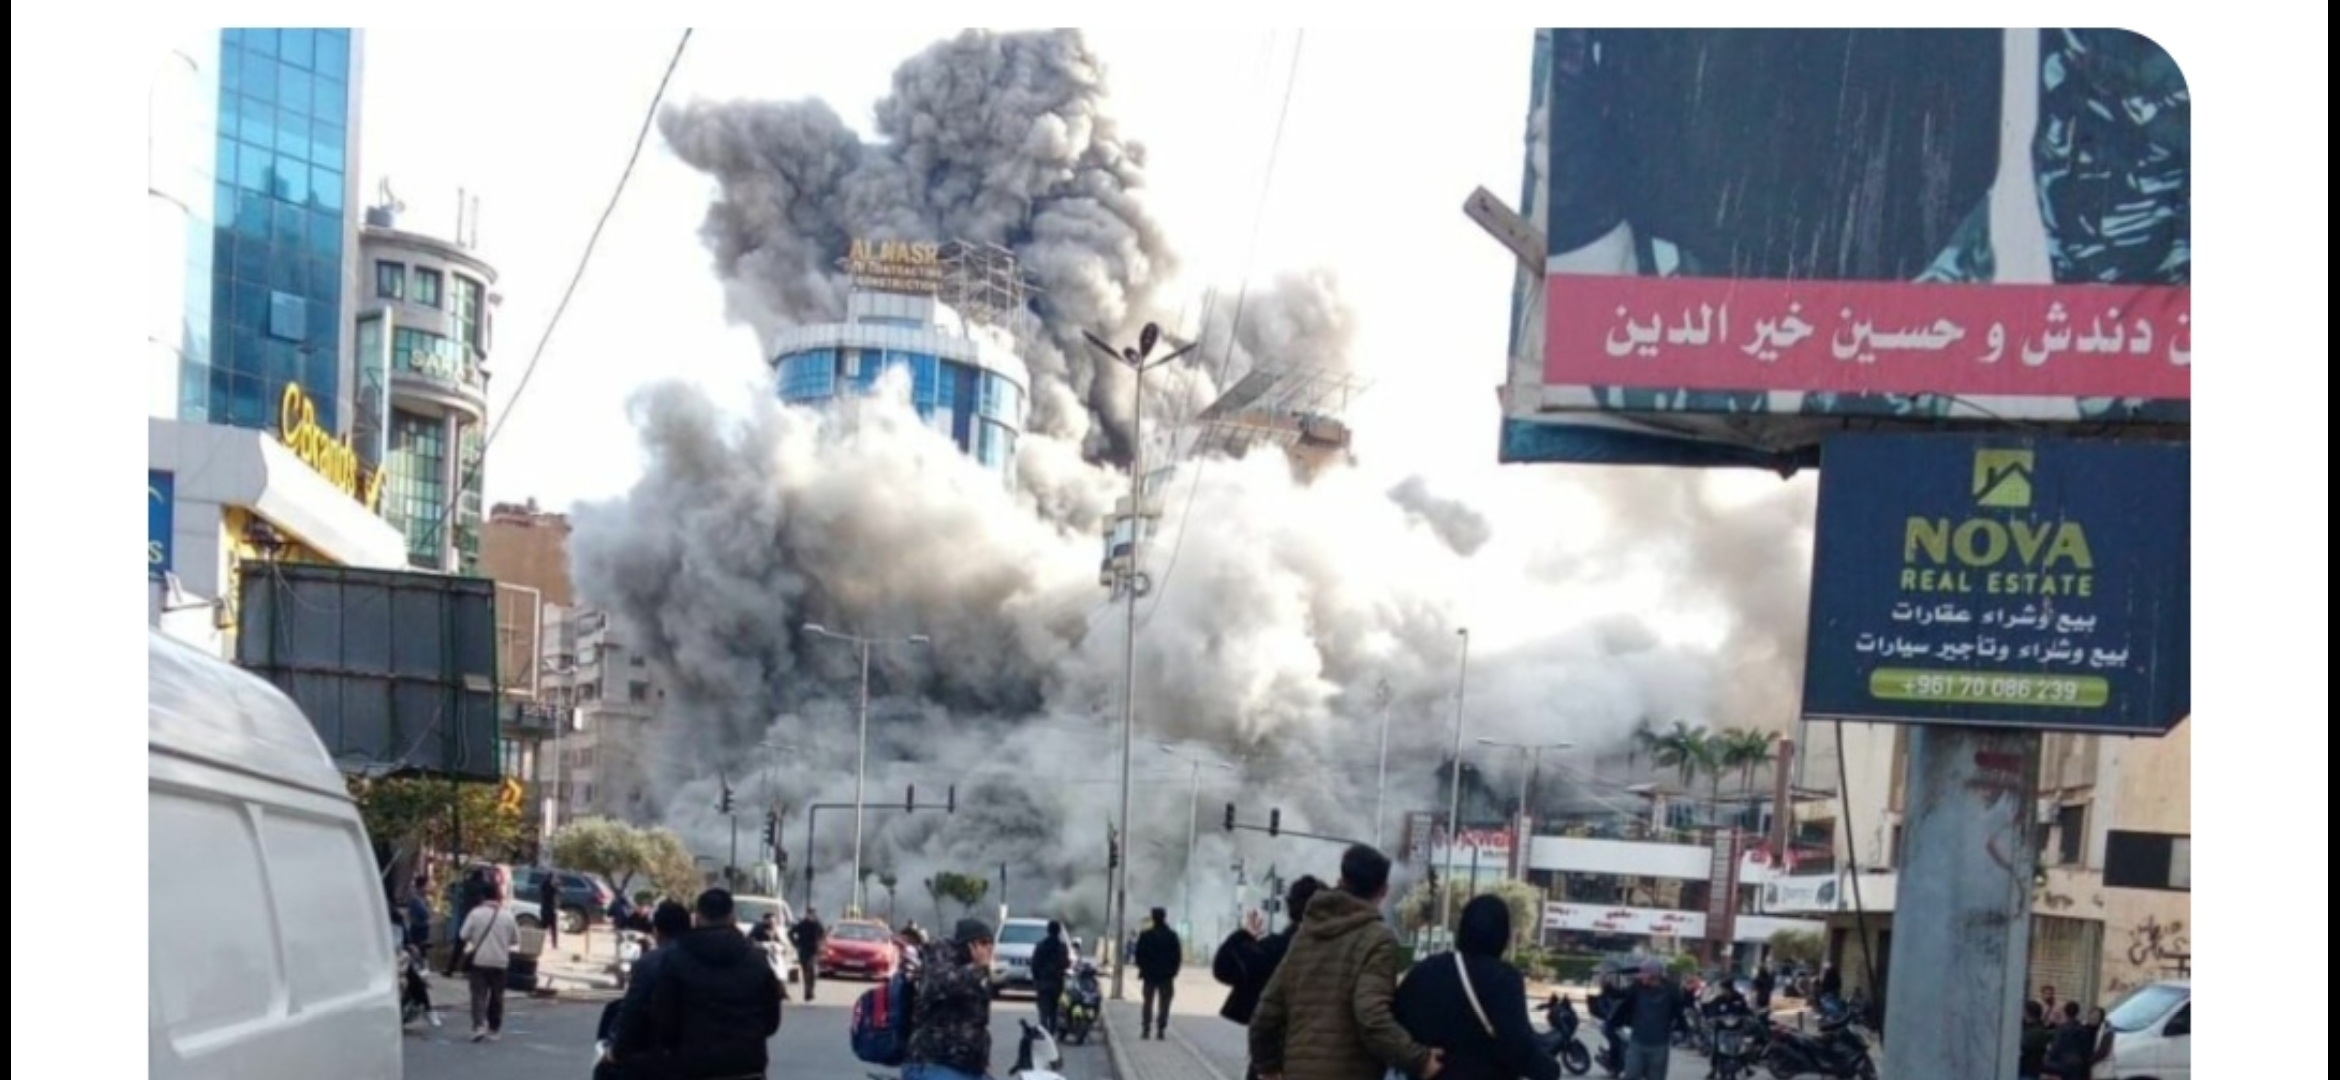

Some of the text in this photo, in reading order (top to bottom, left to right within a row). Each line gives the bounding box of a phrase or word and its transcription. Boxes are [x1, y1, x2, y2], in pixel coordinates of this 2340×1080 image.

[849, 239, 937, 264] AL NASR
[1606, 302, 1727, 356] الدين
[1740, 302, 1814, 361] خير
[1832, 307, 1965, 363] حسين
[1977, 321, 2004, 363] و
[2021, 301, 2152, 366] دندش
[1904, 516, 2093, 568] NOVA
[1901, 569, 2093, 596] REAL ESTATE
[1891, 602, 2097, 633] بيع وشراء عقارات
[1855, 633, 2130, 667] بيع وشراء وتأجير سيارات
[1903, 675, 2079, 700] +961 70 086 239
